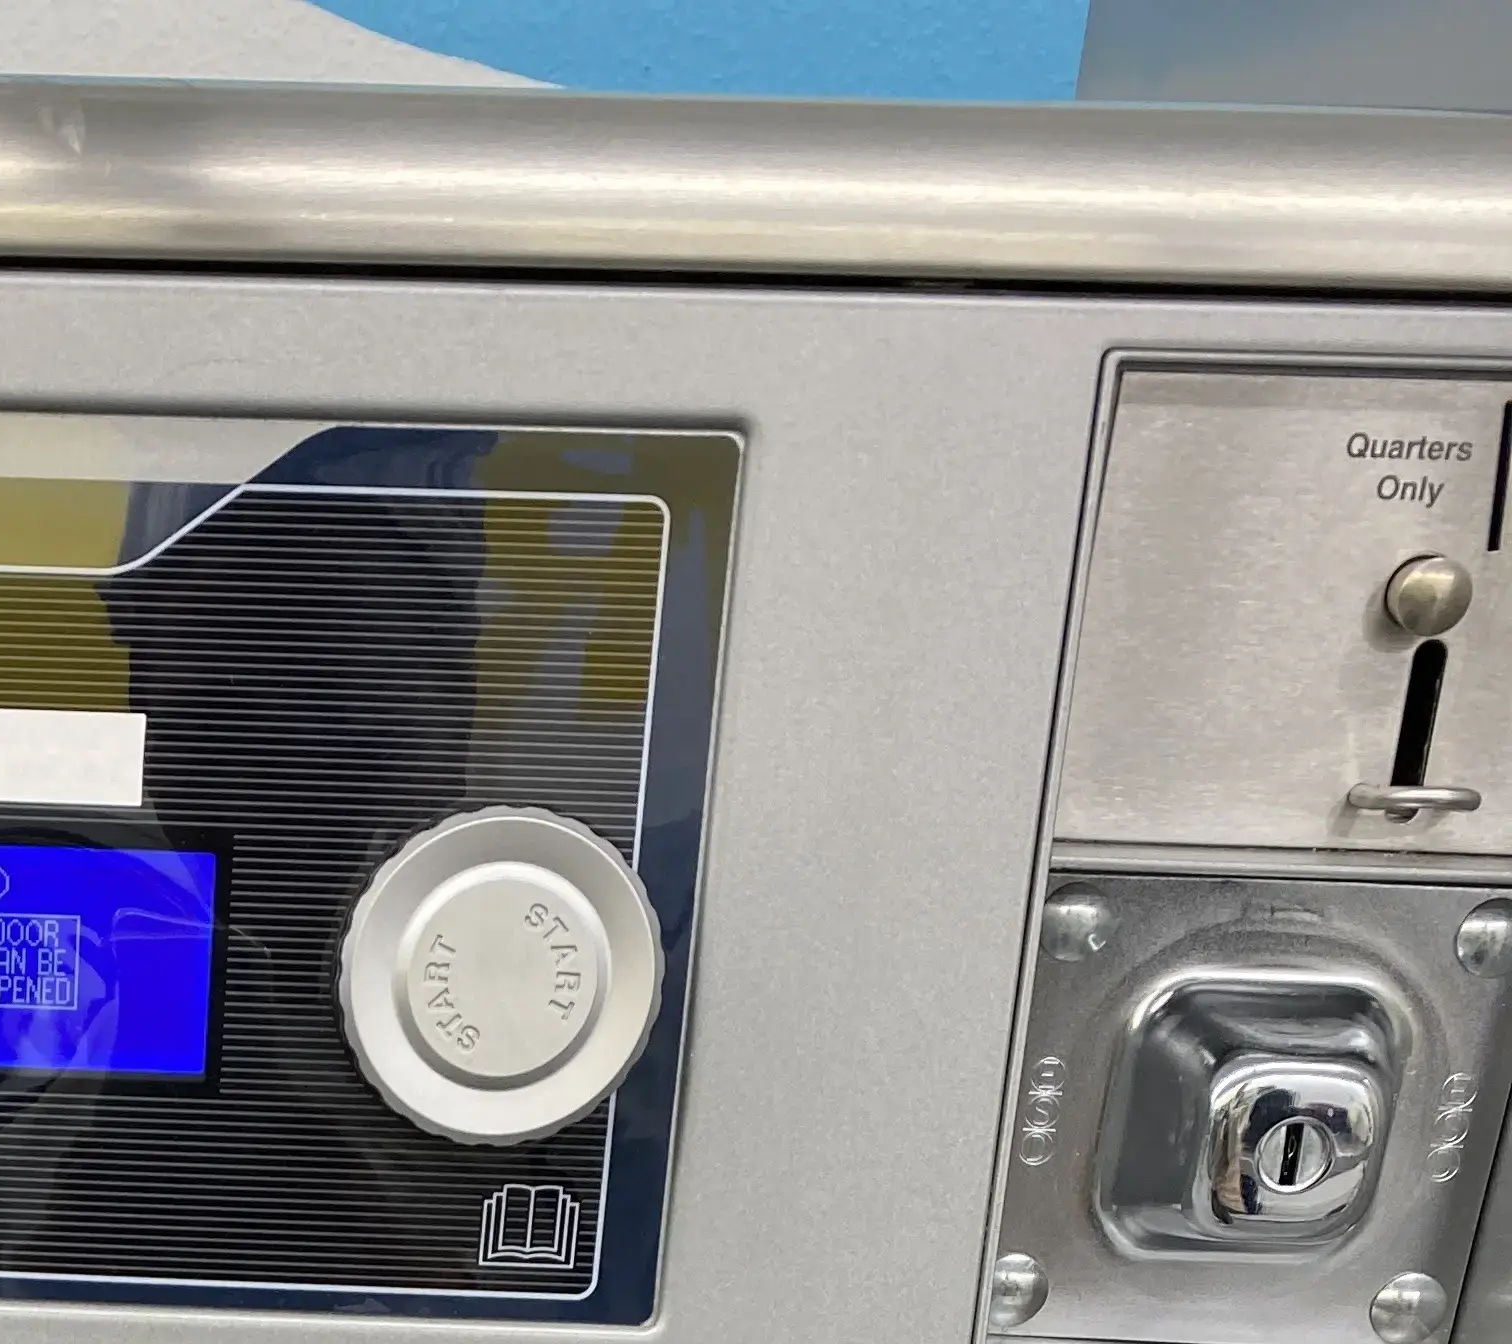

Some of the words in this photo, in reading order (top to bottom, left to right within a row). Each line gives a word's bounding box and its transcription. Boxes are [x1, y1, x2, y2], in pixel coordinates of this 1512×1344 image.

[1346, 432, 1473, 462] Quarters
[1377, 474, 1445, 508] Only
[38, 948, 67, 977] BE
[524, 902, 582, 1021] START
[423, 933, 481, 1053] START
